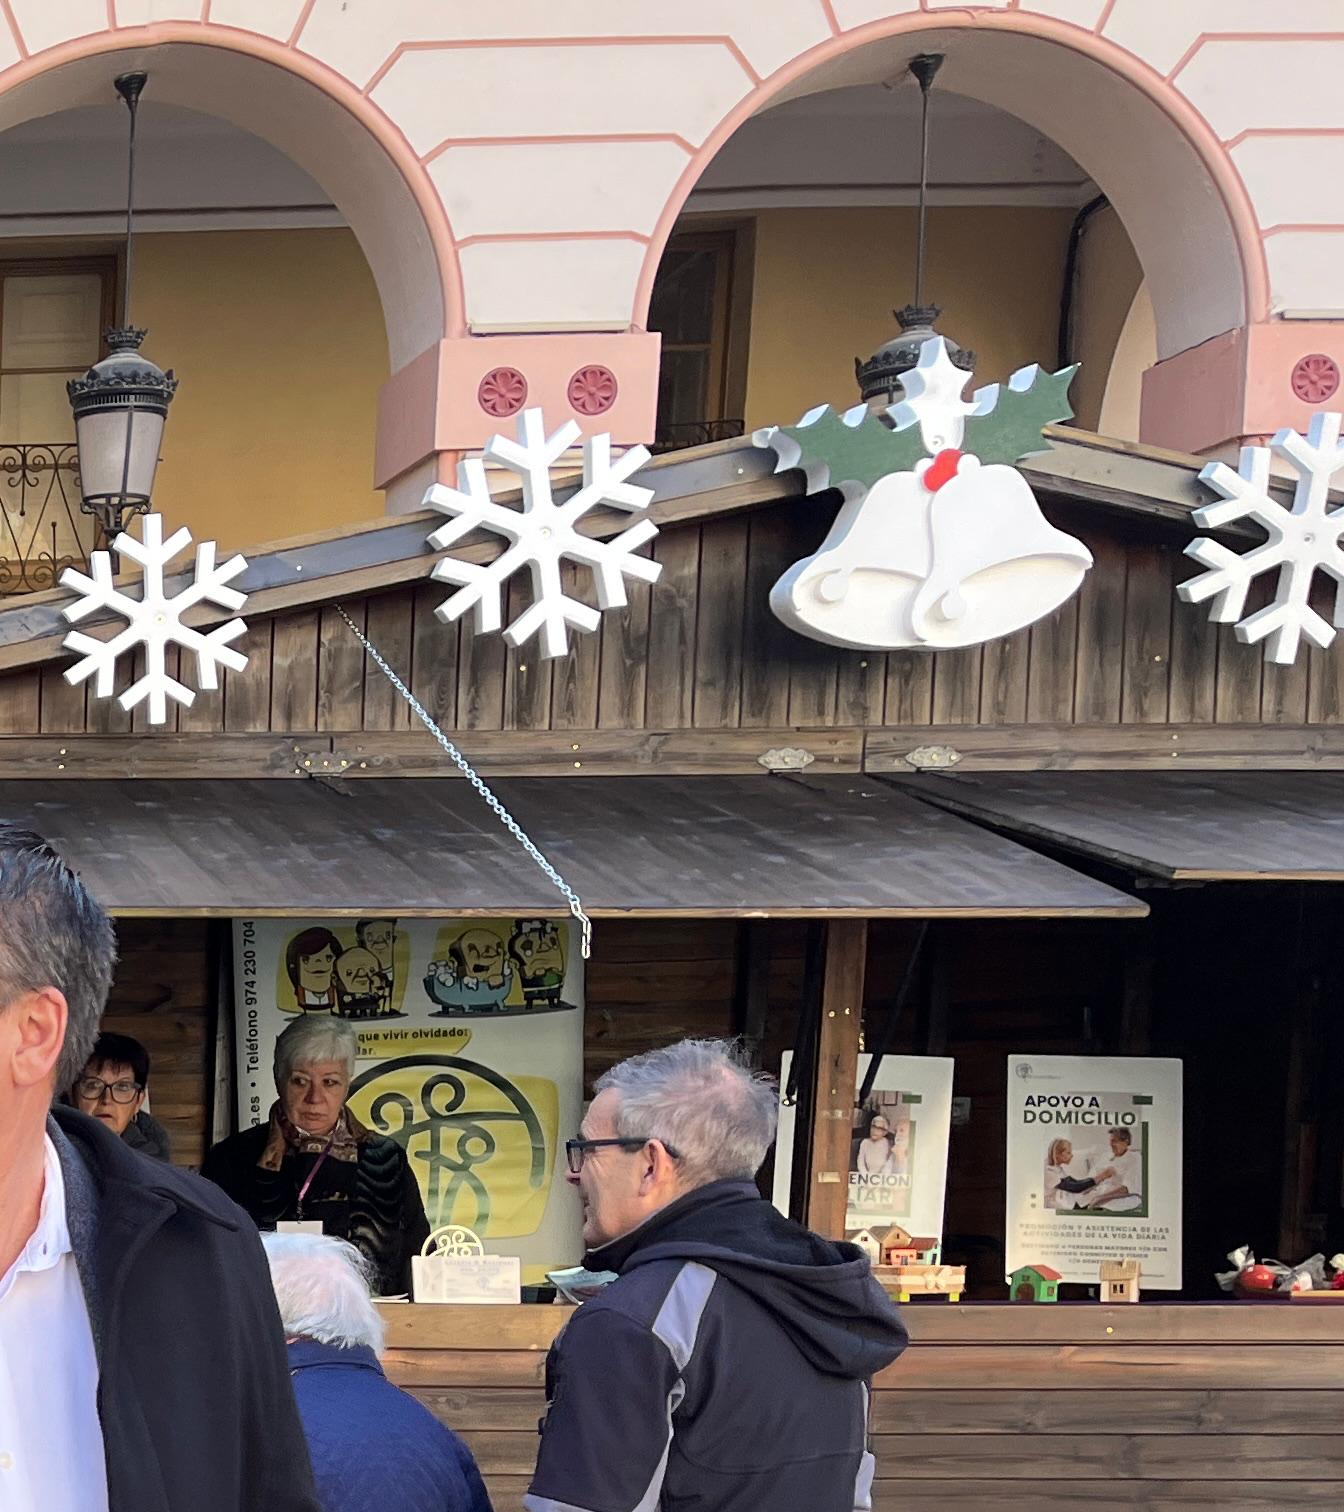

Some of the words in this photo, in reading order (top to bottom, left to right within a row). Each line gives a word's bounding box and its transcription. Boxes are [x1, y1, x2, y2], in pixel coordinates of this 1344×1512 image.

[242, 921, 256, 947] 704
[243, 950, 257, 976] 230
[244, 980, 258, 1005] 974
[246, 1009, 259, 1074] Teléfono
[357, 1032, 380, 1043] que
[383, 1030, 409, 1040] vivir
[1024, 1095, 1088, 1108] APOYO
[1088, 1096, 1100, 1108] A
[1023, 1110, 1136, 1126] DOMICILIO
[849, 1173, 909, 1187] ENCION
